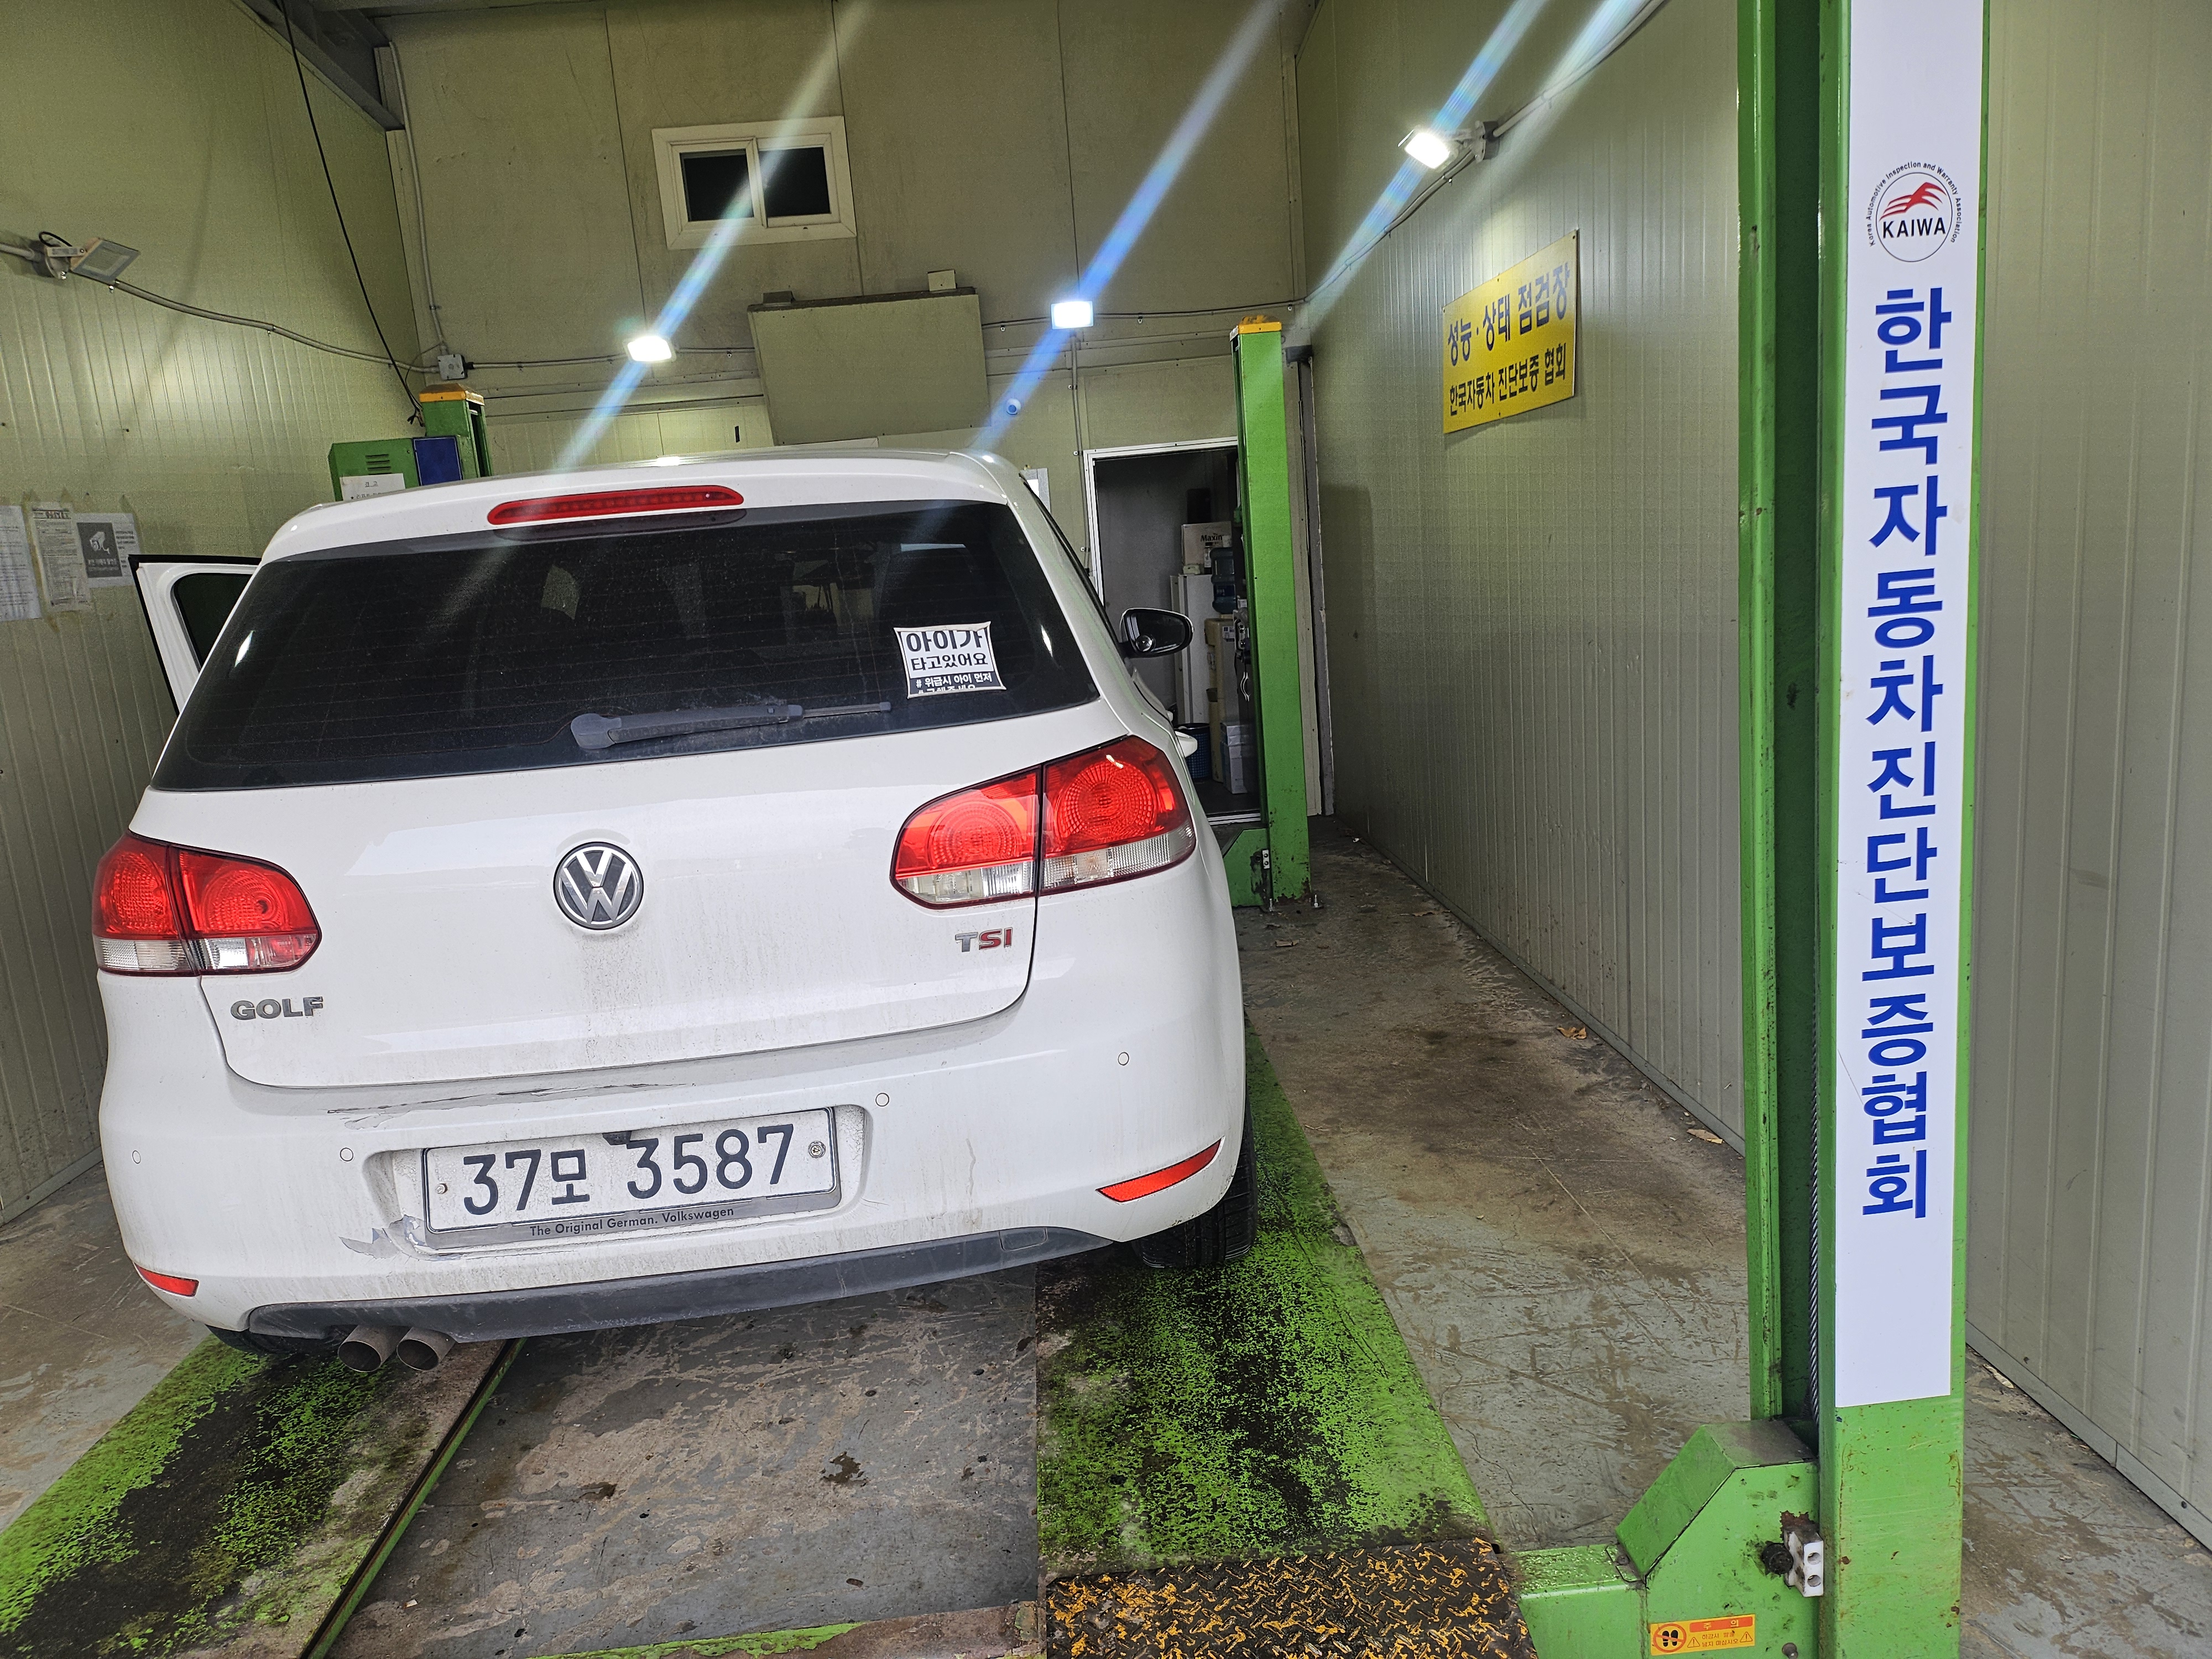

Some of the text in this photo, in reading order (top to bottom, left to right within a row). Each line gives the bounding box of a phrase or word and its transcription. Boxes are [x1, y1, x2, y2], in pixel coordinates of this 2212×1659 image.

[1866, 161, 1962, 247] Korea Automotive Inspection and Warranty Association
[1883, 217, 1946, 238] KAIWA
[1518, 263, 1570, 336] 점검장
[1449, 343, 1567, 416] 한국자동차 진단보증 협회
[906, 630, 983, 652] 아이가
[911, 653, 988, 671] 타고있어요
[925, 676, 951, 687] 위급시
[954, 674, 972, 684] 아이
[974, 672, 992, 682] 먼저
[1861, 286, 1952, 1219] 한국자동차진단보증협회
[955, 927, 1013, 952] TSI
[230, 996, 324, 1020] GOLF
[462, 1123, 795, 1216] 37모 3587
[530, 1225, 552, 1238] The
[555, 1219, 603, 1235] Original
[662, 1206, 734, 1224] Volkswagen
[1703, 1619, 1739, 1630] 주 의
